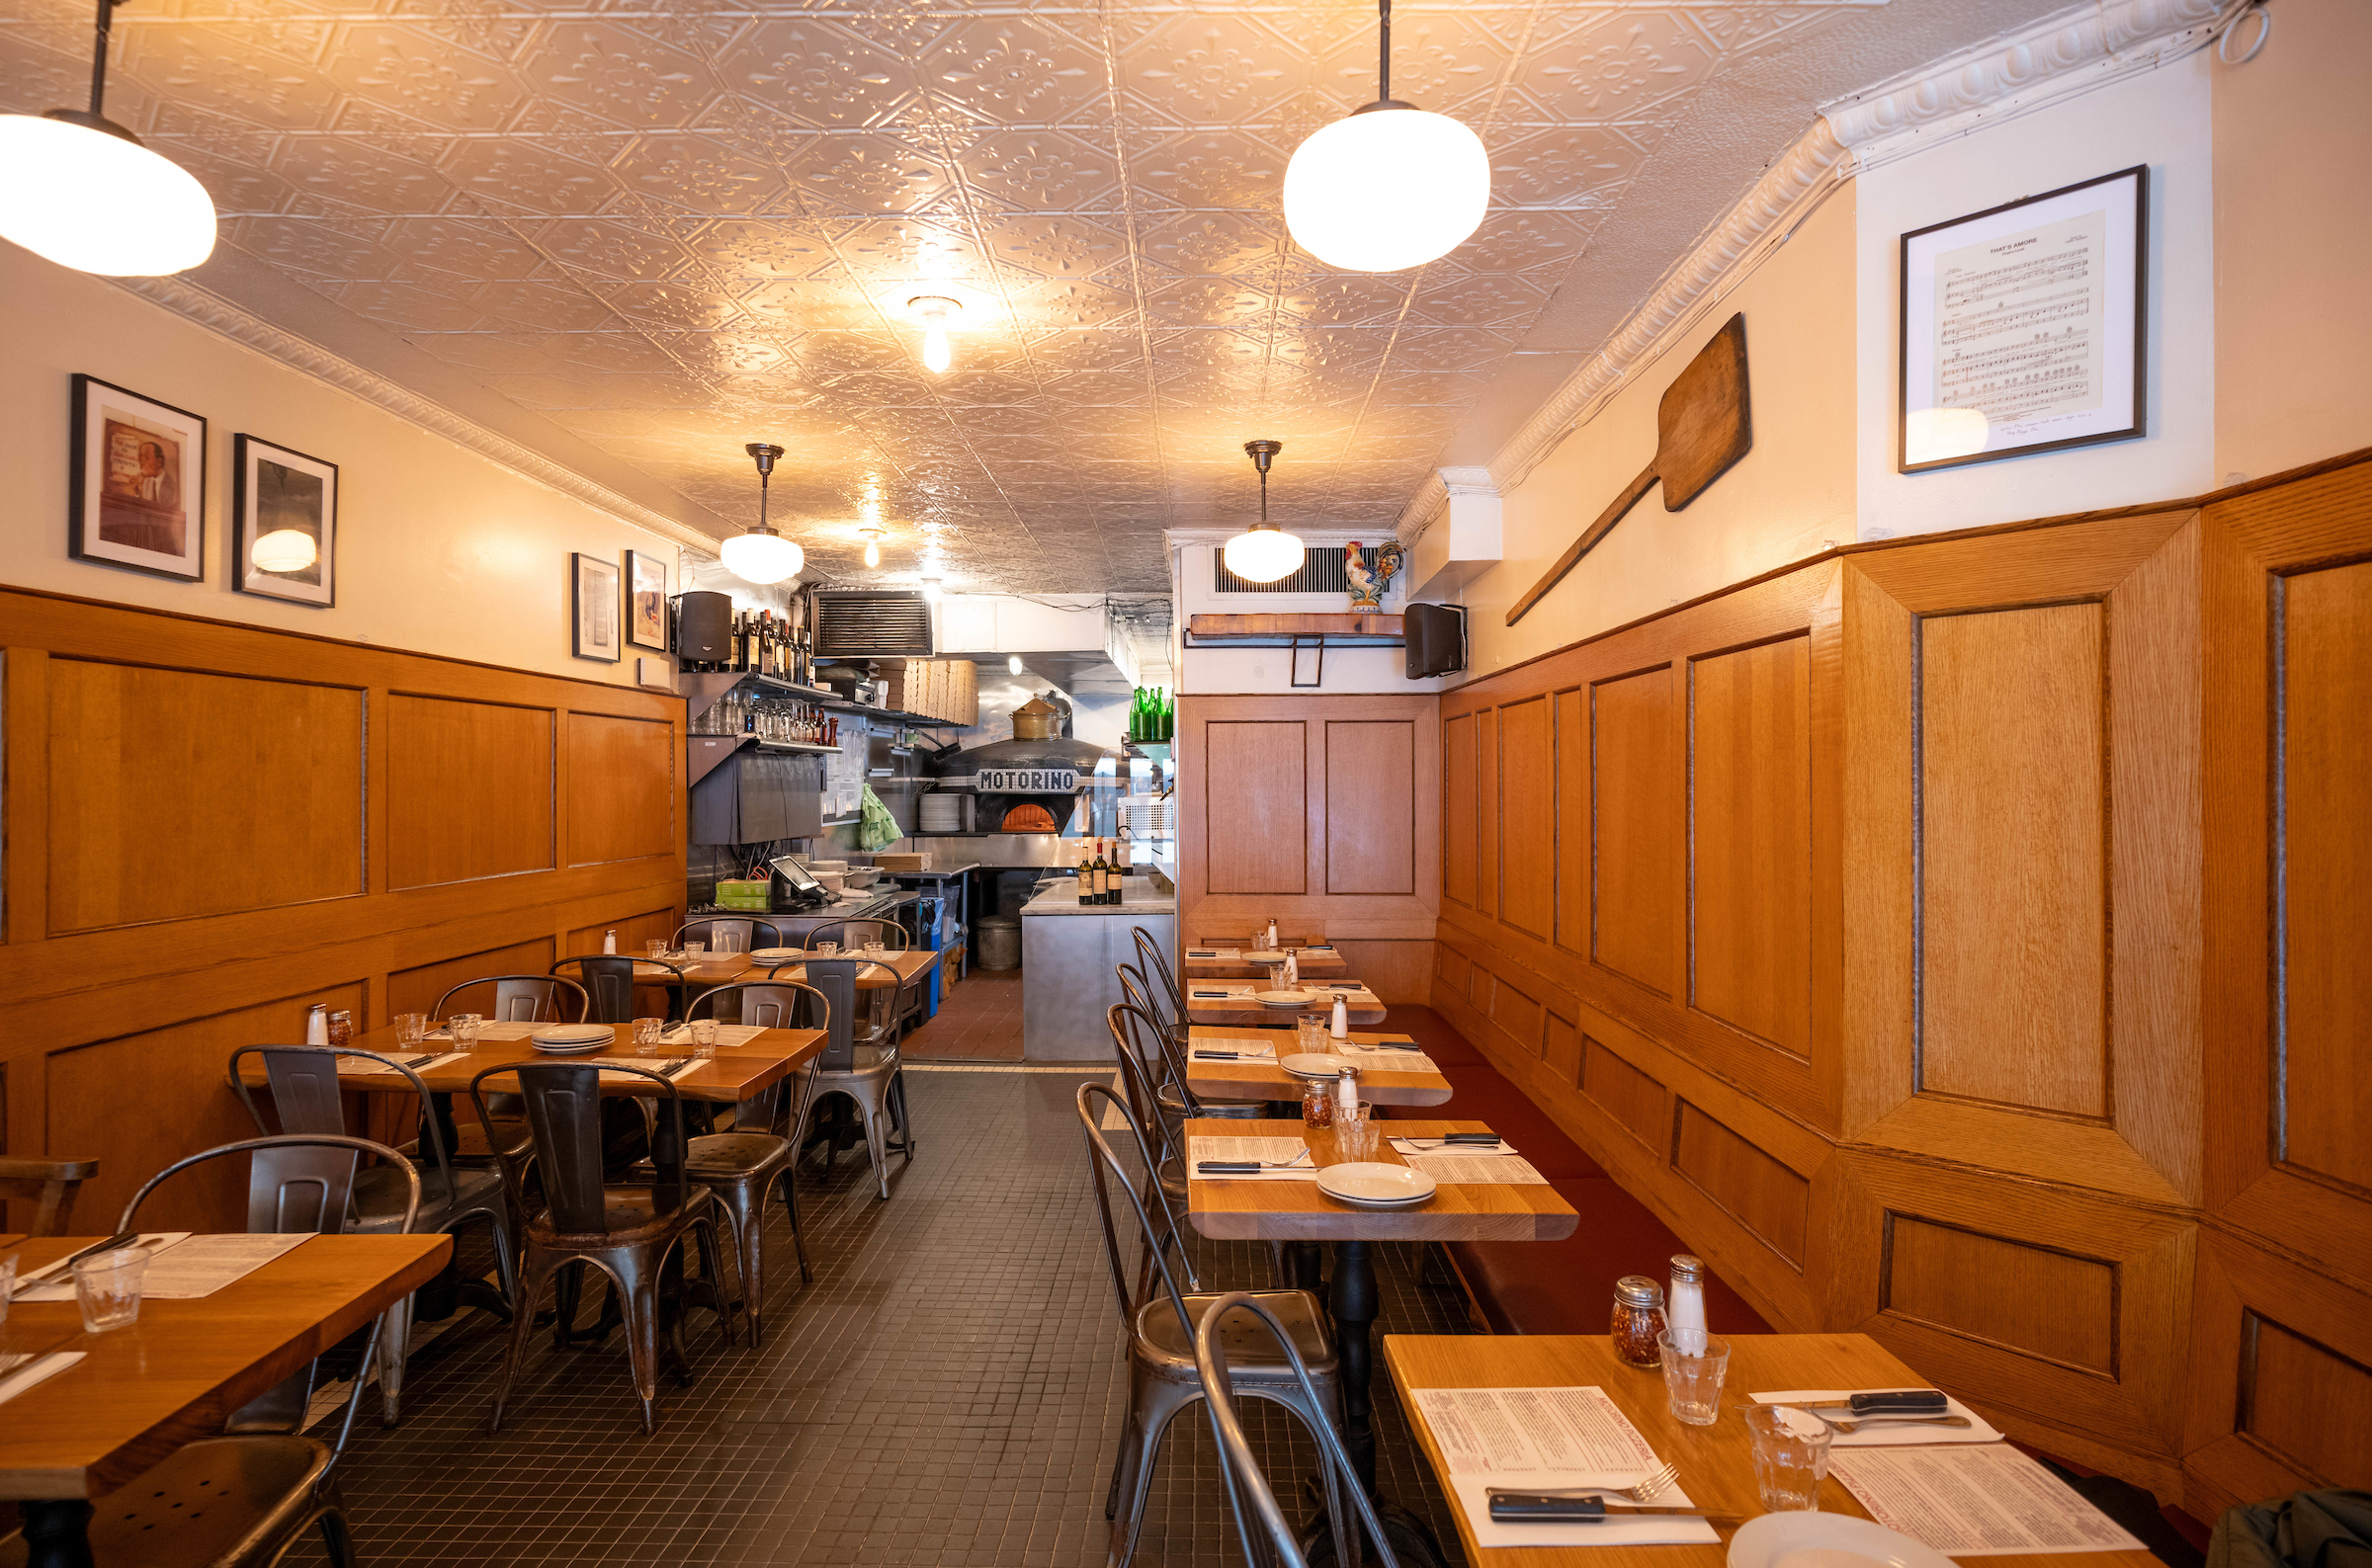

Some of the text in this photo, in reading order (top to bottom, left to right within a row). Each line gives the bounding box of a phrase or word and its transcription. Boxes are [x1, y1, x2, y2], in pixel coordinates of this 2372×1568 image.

[1990, 237, 2038, 254] THAT'S AMORE
[980, 772, 1073, 789] MOTORINO
[1596, 1397, 1653, 1460] MOTORINO PIZZERIA
